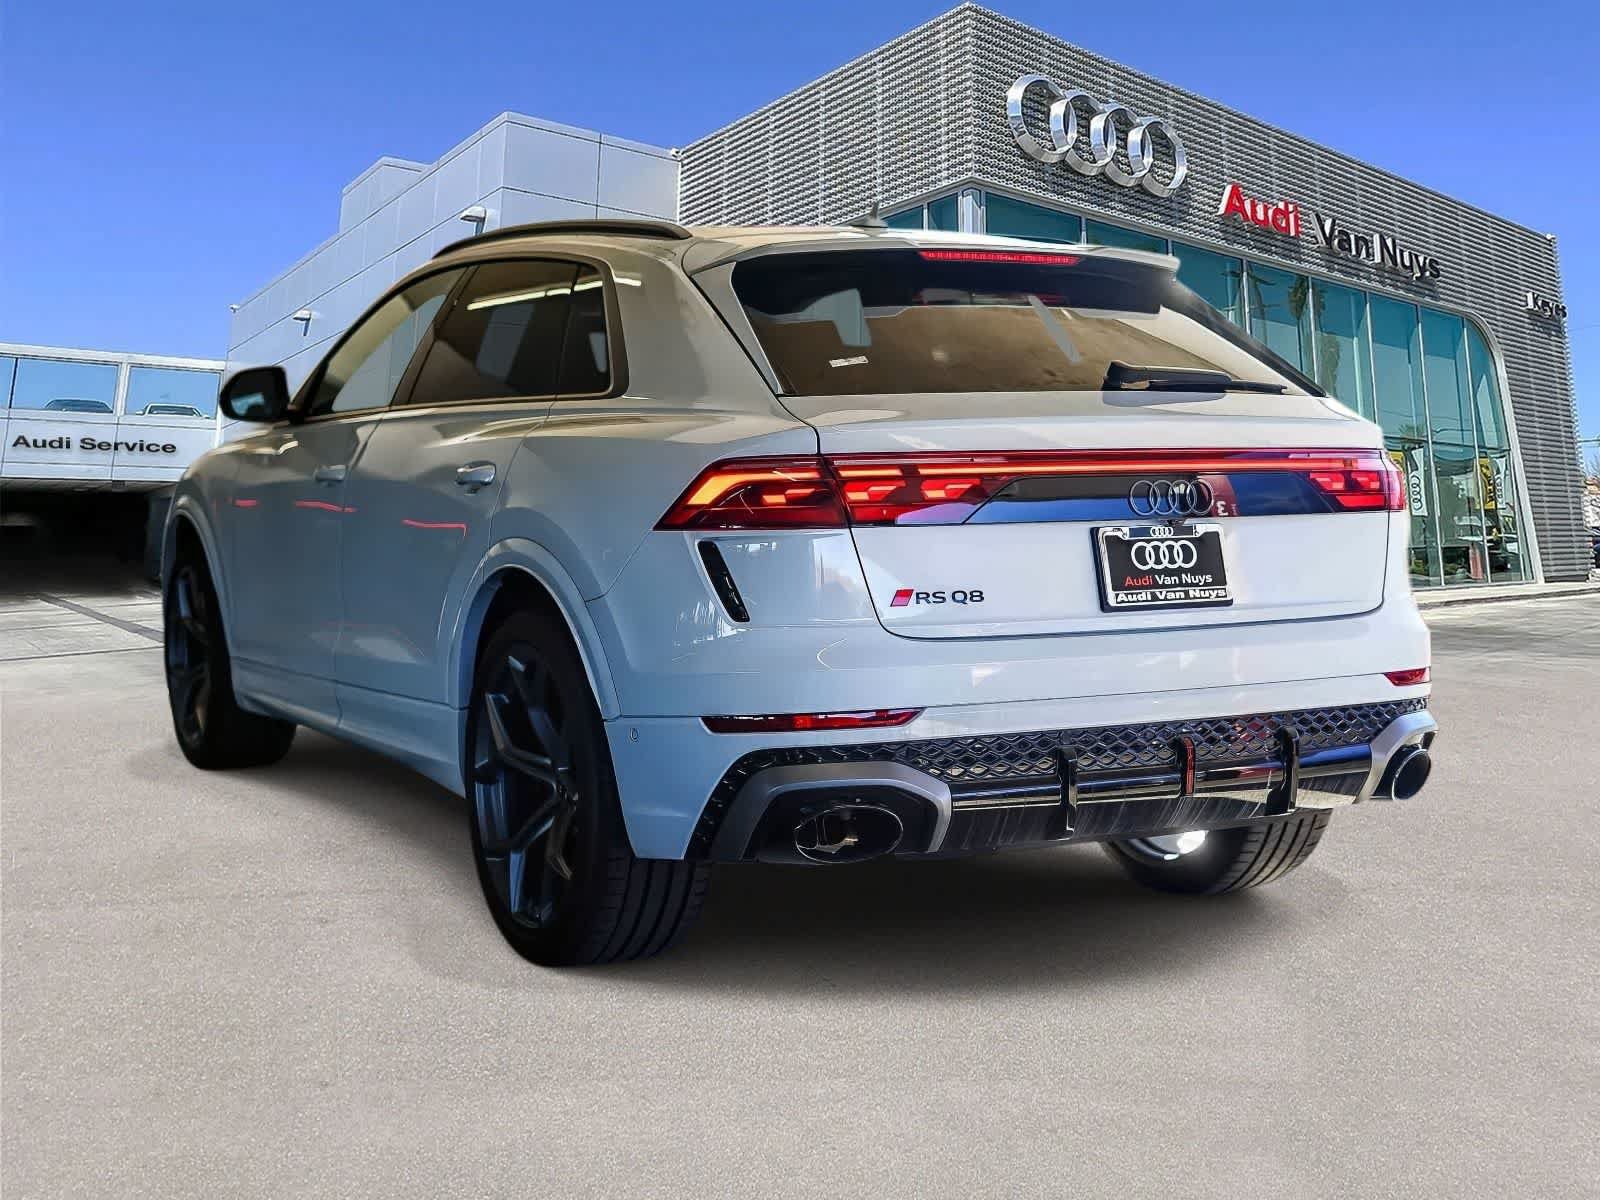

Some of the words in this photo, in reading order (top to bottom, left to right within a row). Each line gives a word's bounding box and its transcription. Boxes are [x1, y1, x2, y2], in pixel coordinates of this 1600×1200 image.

[1217, 182, 1301, 238] Audi
[1312, 212, 1371, 259] Van
[1373, 232, 1441, 281] Nuys
[12, 435, 71, 450] Audi
[79, 437, 178, 454] Service
[1124, 575, 1153, 587] Audi
[1155, 574, 1179, 585] Van
[1181, 572, 1213, 586] Nuys
[915, 591, 947, 605] RS
[951, 590, 985, 605] Q8
[1116, 591, 1151, 603] Audi
[1155, 589, 1185, 601] Van
[1189, 587, 1227, 600] Nuys
